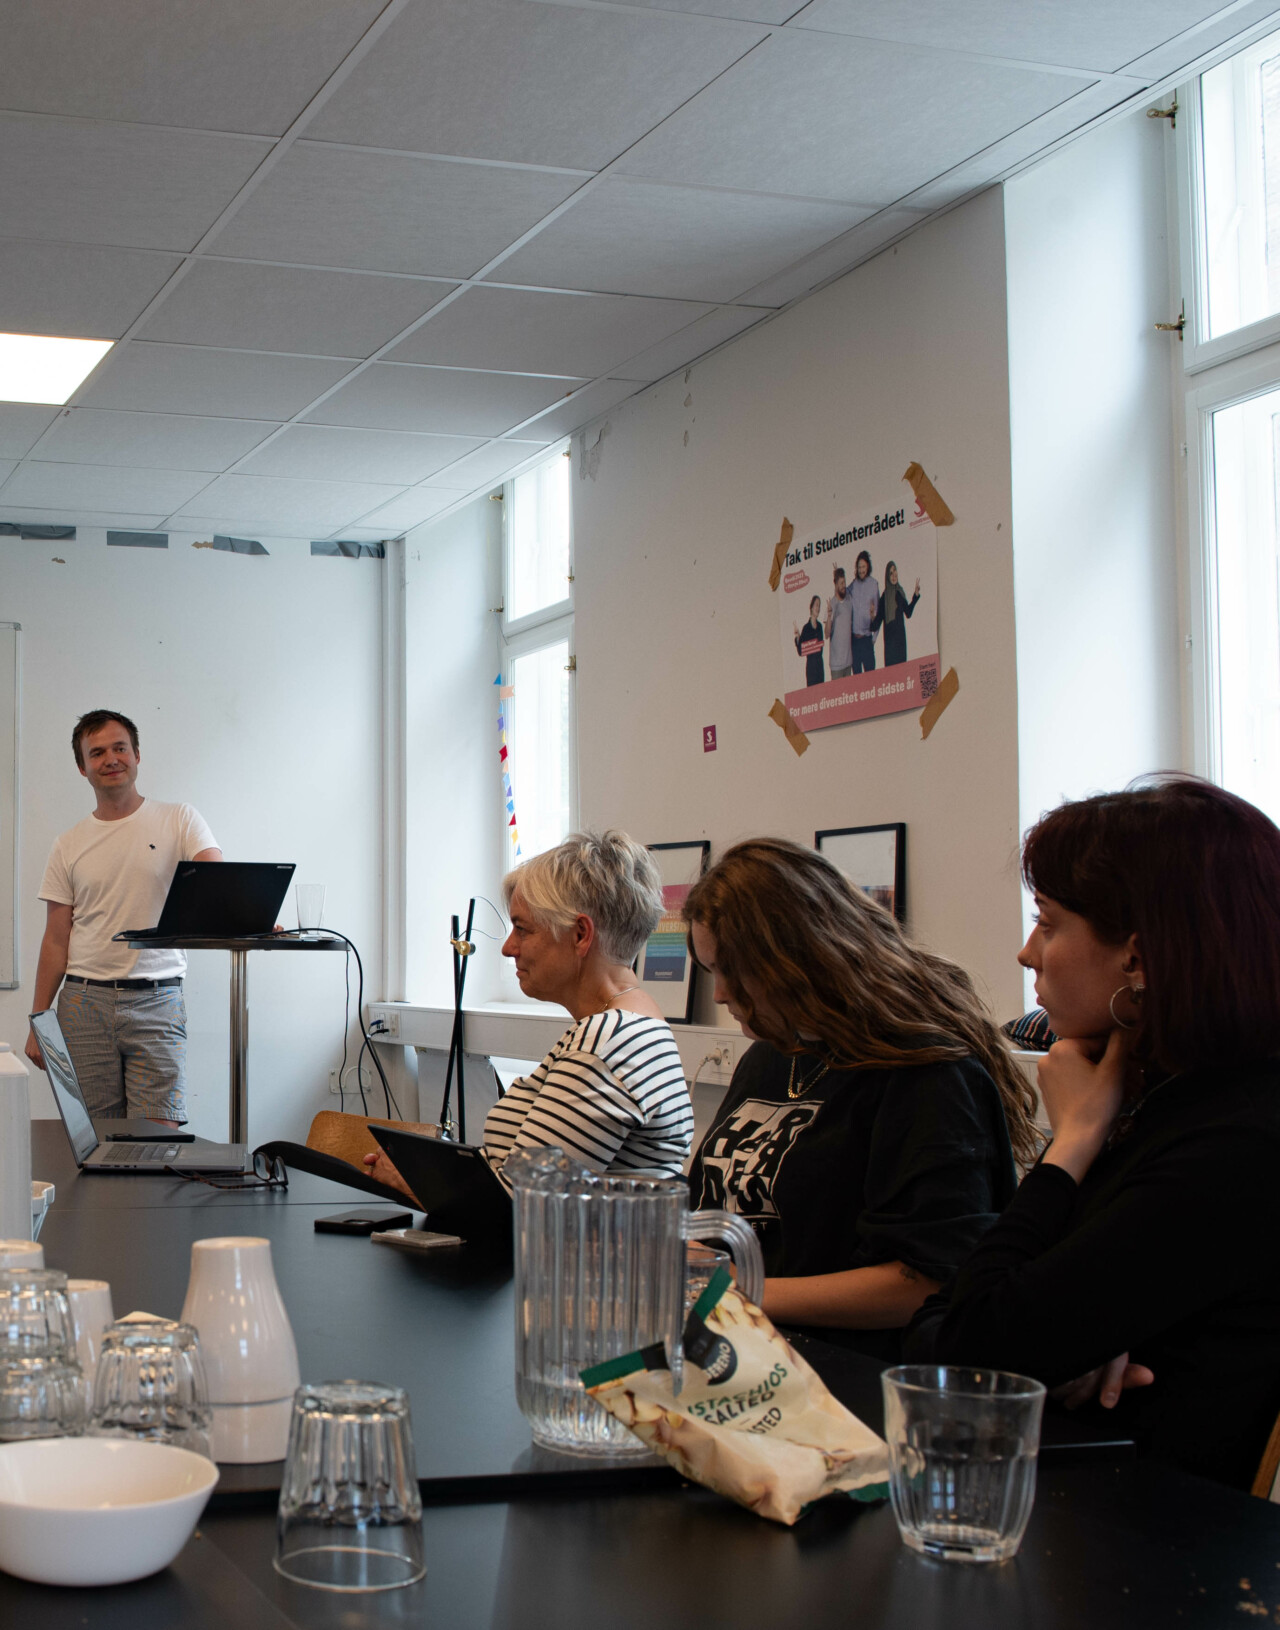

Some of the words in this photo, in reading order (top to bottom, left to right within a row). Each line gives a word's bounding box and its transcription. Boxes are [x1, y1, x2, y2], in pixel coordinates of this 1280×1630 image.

[785, 548, 802, 568] Tak
[803, 542, 814, 561] til
[815, 509, 905, 555] Studenterrådet!
[789, 706, 801, 718] For
[801, 704, 818, 715] mere
[819, 691, 859, 710] diversitet
[859, 686, 876, 701] end
[877, 682, 906, 697] sidste
[906, 676, 915, 690] år
